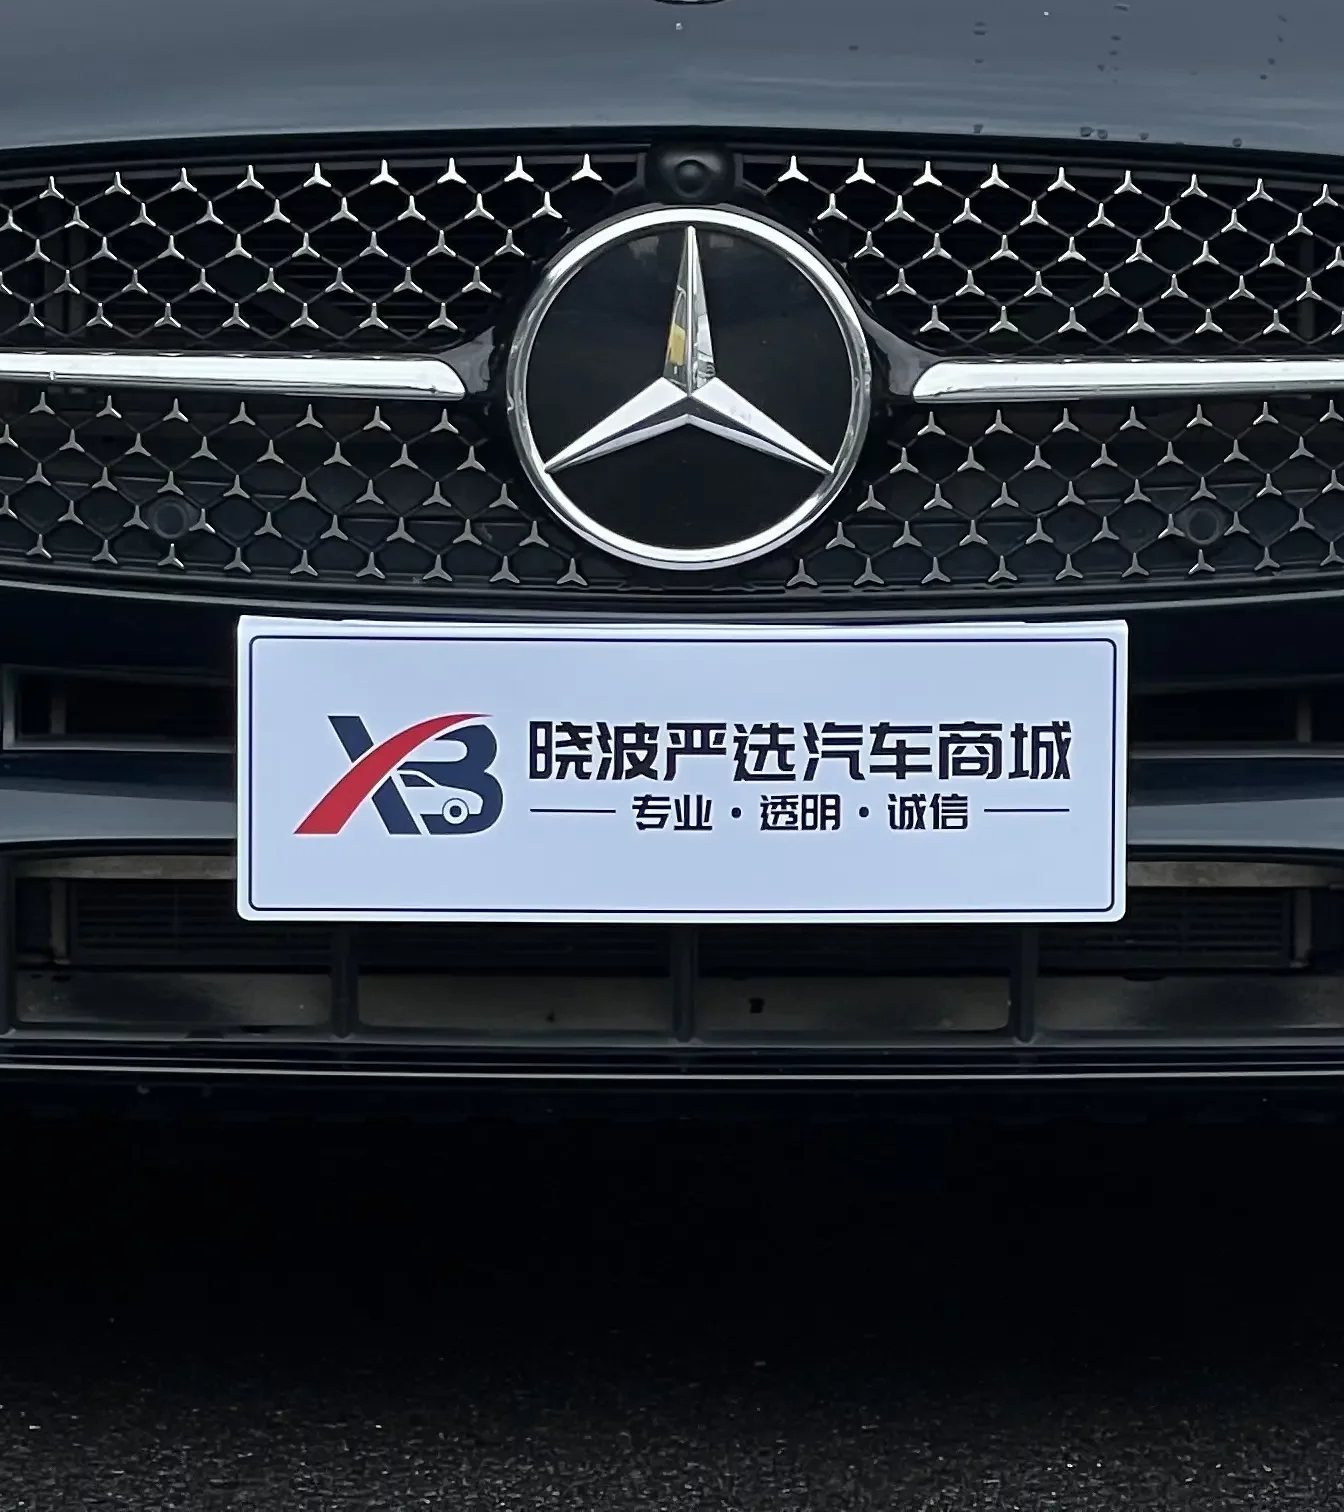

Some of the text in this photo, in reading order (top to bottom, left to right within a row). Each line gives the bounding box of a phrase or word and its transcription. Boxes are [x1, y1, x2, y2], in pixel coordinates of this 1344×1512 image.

[528, 719, 1073, 783] 晓波严选汽车商城
